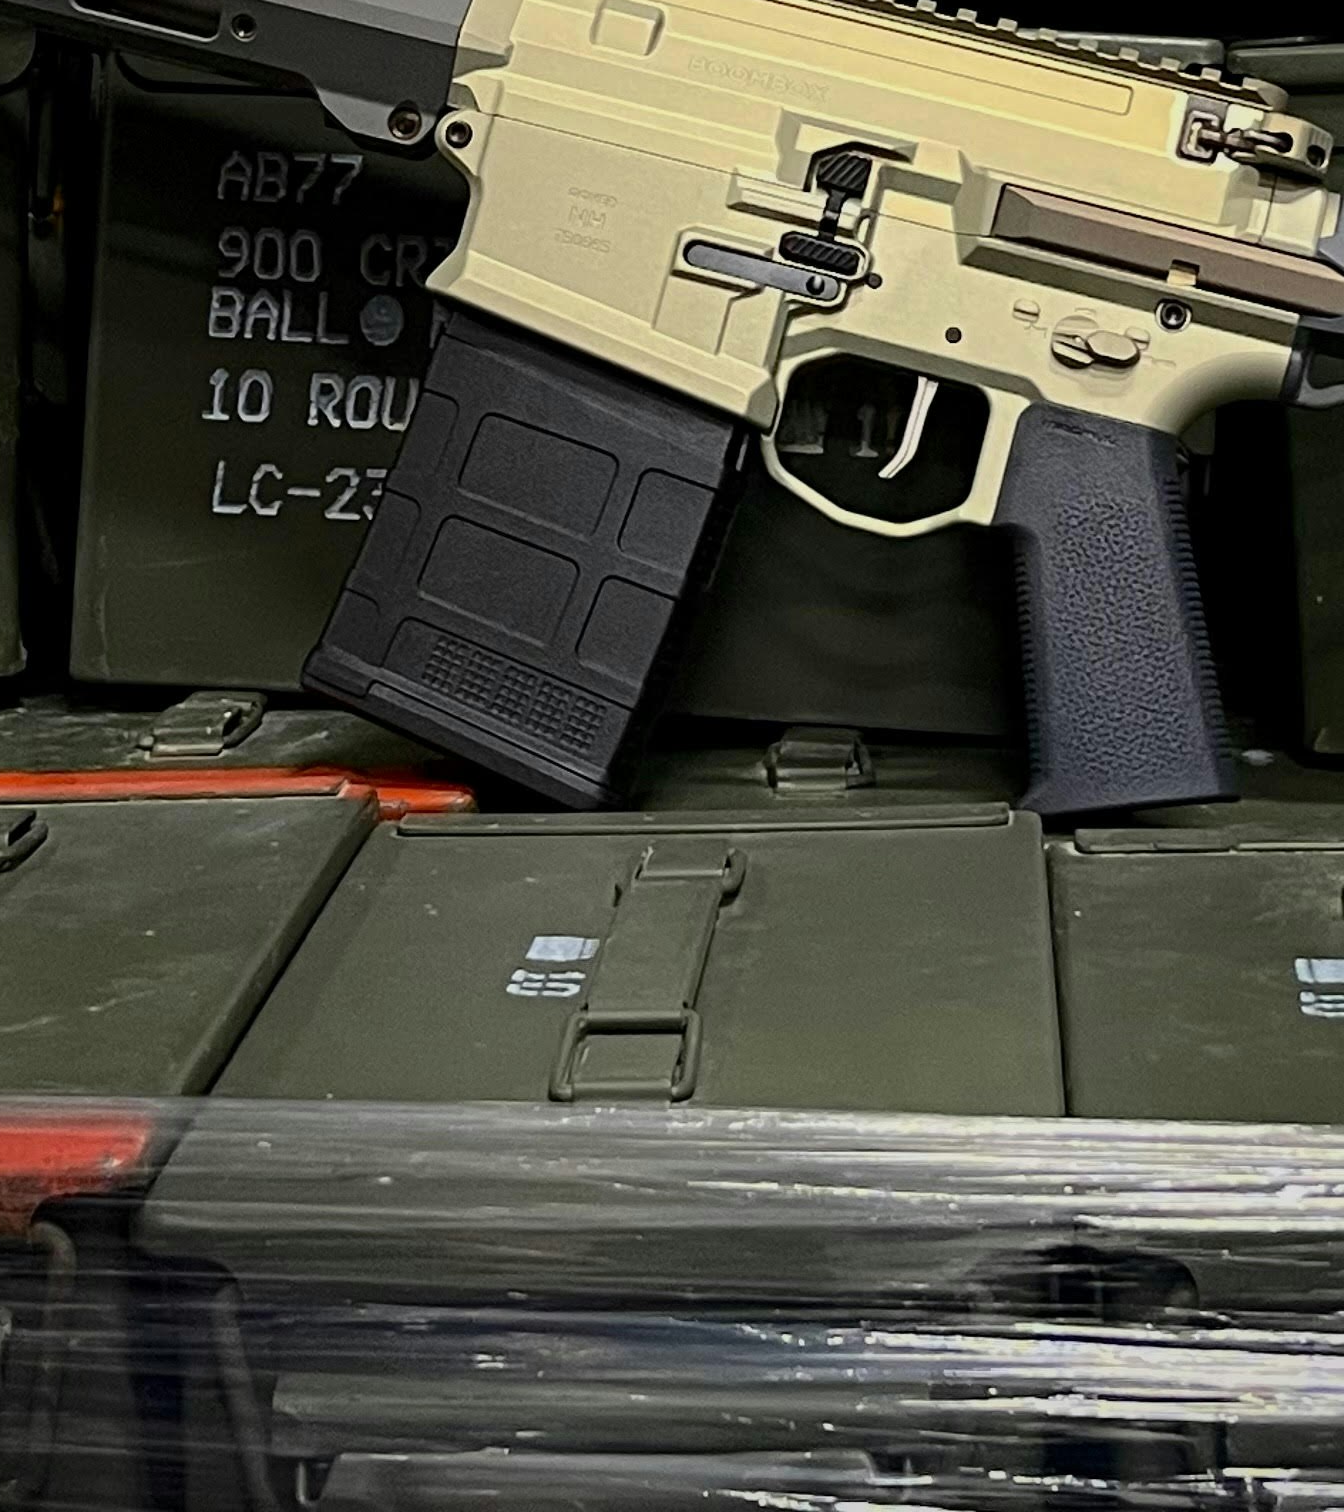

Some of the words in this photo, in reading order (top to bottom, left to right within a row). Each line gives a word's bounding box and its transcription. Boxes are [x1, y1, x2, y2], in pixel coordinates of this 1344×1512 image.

[218, 151, 363, 204] AB77
[219, 226, 321, 283] 900
[208, 287, 349, 344] BALL
[202, 368, 273, 422] 10
